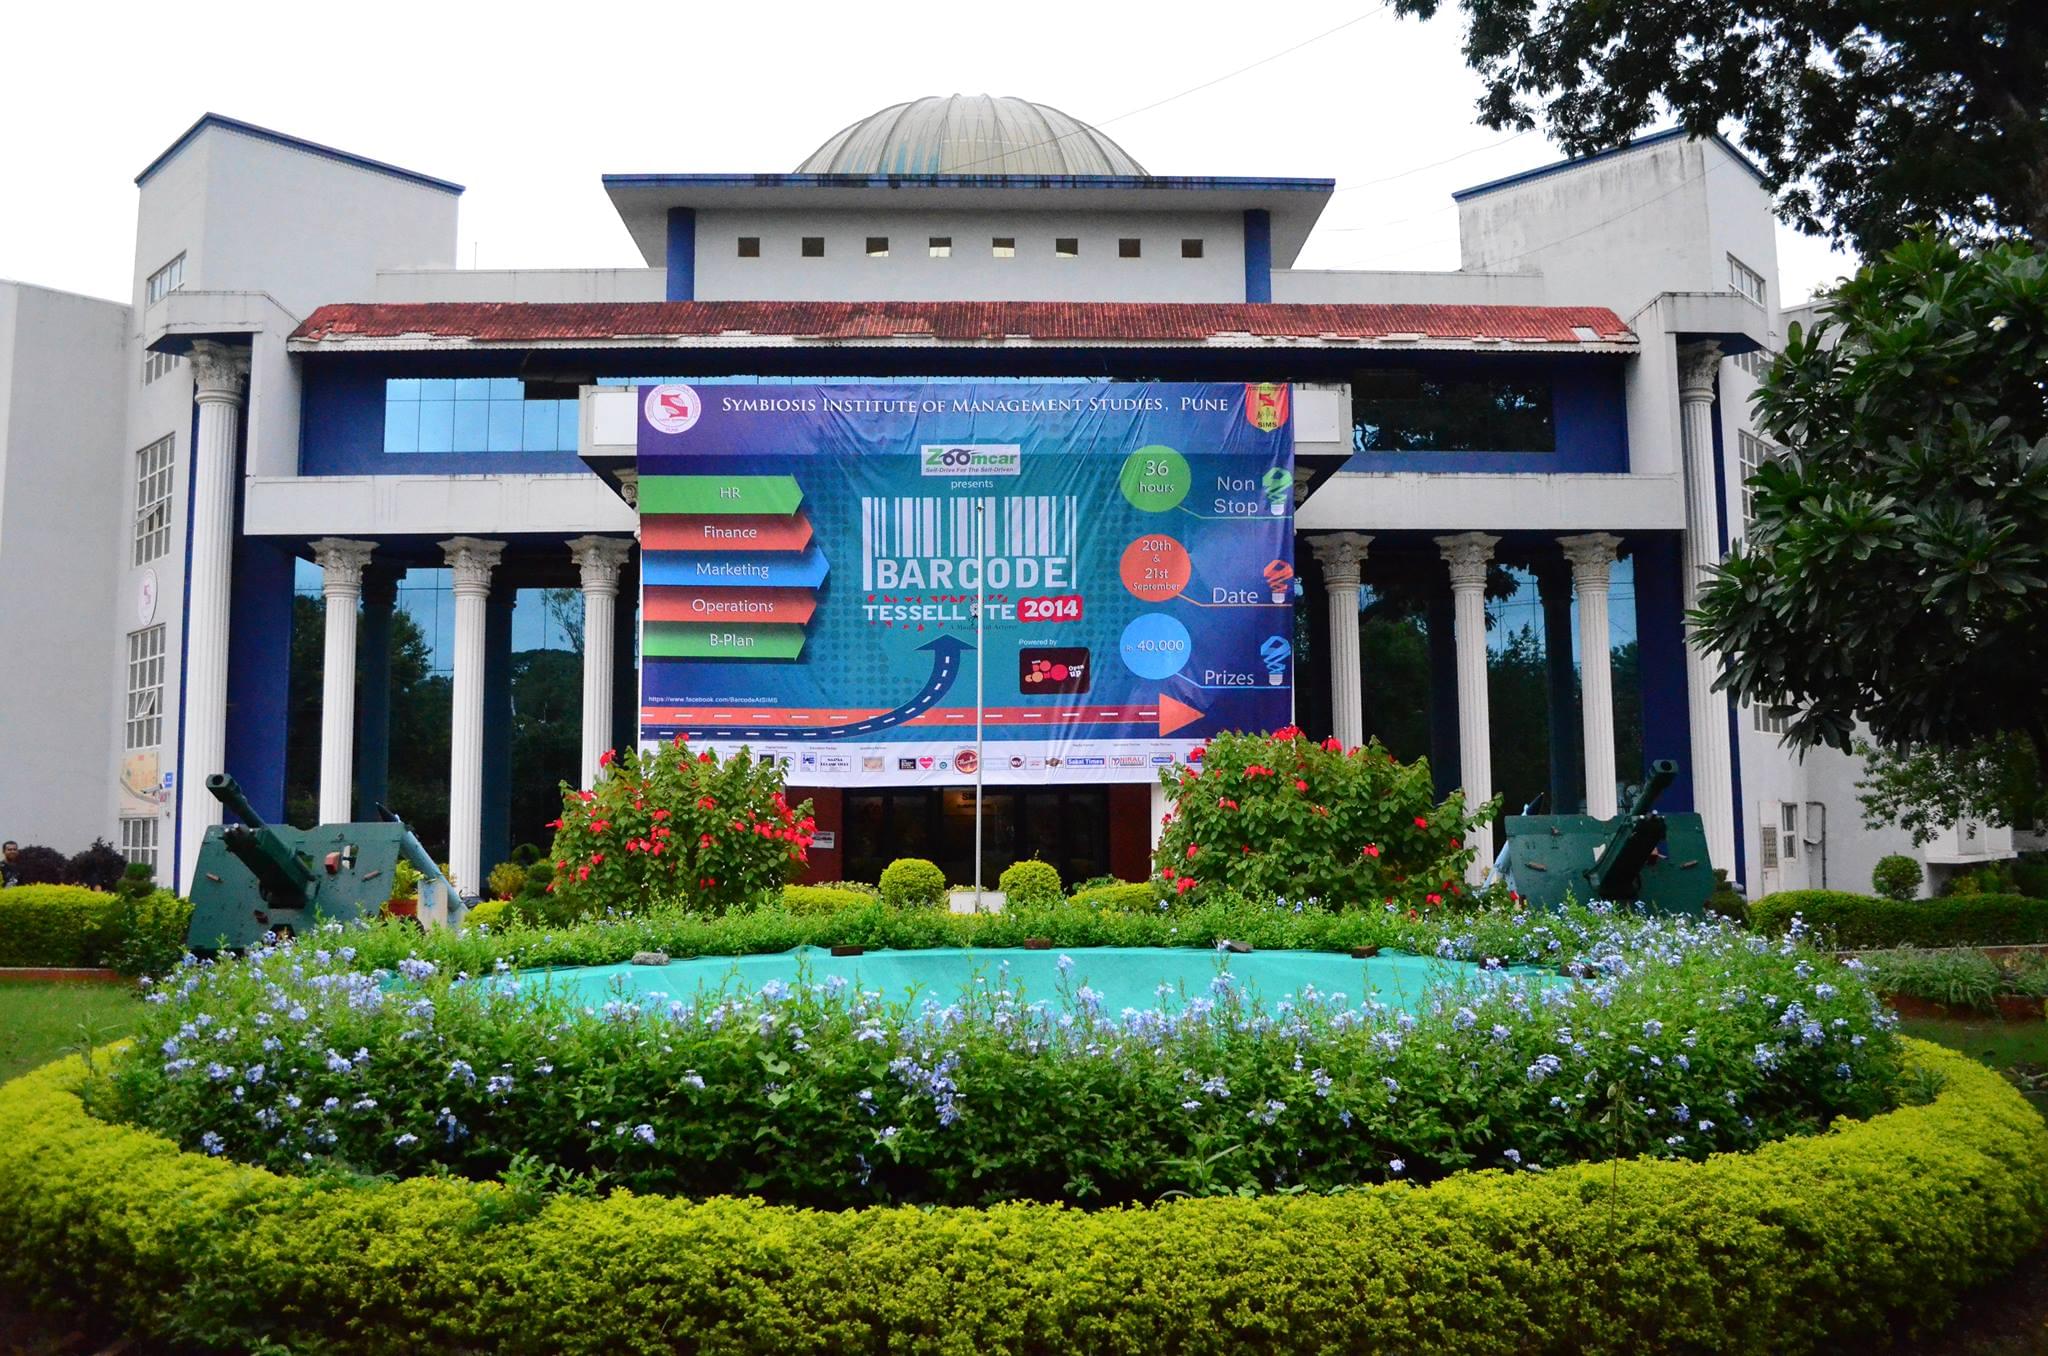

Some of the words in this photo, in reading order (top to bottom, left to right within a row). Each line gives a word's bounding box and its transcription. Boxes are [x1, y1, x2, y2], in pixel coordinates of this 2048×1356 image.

[722, 397, 816, 412] SYMBIOSIS
[823, 397, 917, 413] INSTITUTE
[923, 400, 945, 413] OF
[952, 398, 1083, 412] MANAGEMENT
[1181, 397, 1228, 411] PUNE
[926, 448, 1018, 466] Zoomcar
[1144, 460, 1169, 476] 36
[951, 480, 994, 490] presents
[1139, 481, 1174, 493] hours
[1217, 476, 1255, 492] Non
[720, 487, 741, 499] HR
[1214, 499, 1258, 515] Stop
[704, 526, 757, 538] Finance
[1142, 540, 1171, 551] 20th
[1153, 554, 1161, 563] &
[696, 563, 769, 579] Marketing
[877, 557, 1067, 589] BARCODE
[1145, 568, 1168, 579] 21st
[1133, 582, 1180, 592] September
[1213, 587, 1258, 603] Date
[692, 598, 774, 615] Operations
[1024, 600, 1078, 617] 2014
[710, 633, 754, 646] B-Plan
[1019, 638, 1047, 646] Powered
[1049, 638, 1057, 647] by
[1204, 670, 1254, 685] Prizes
